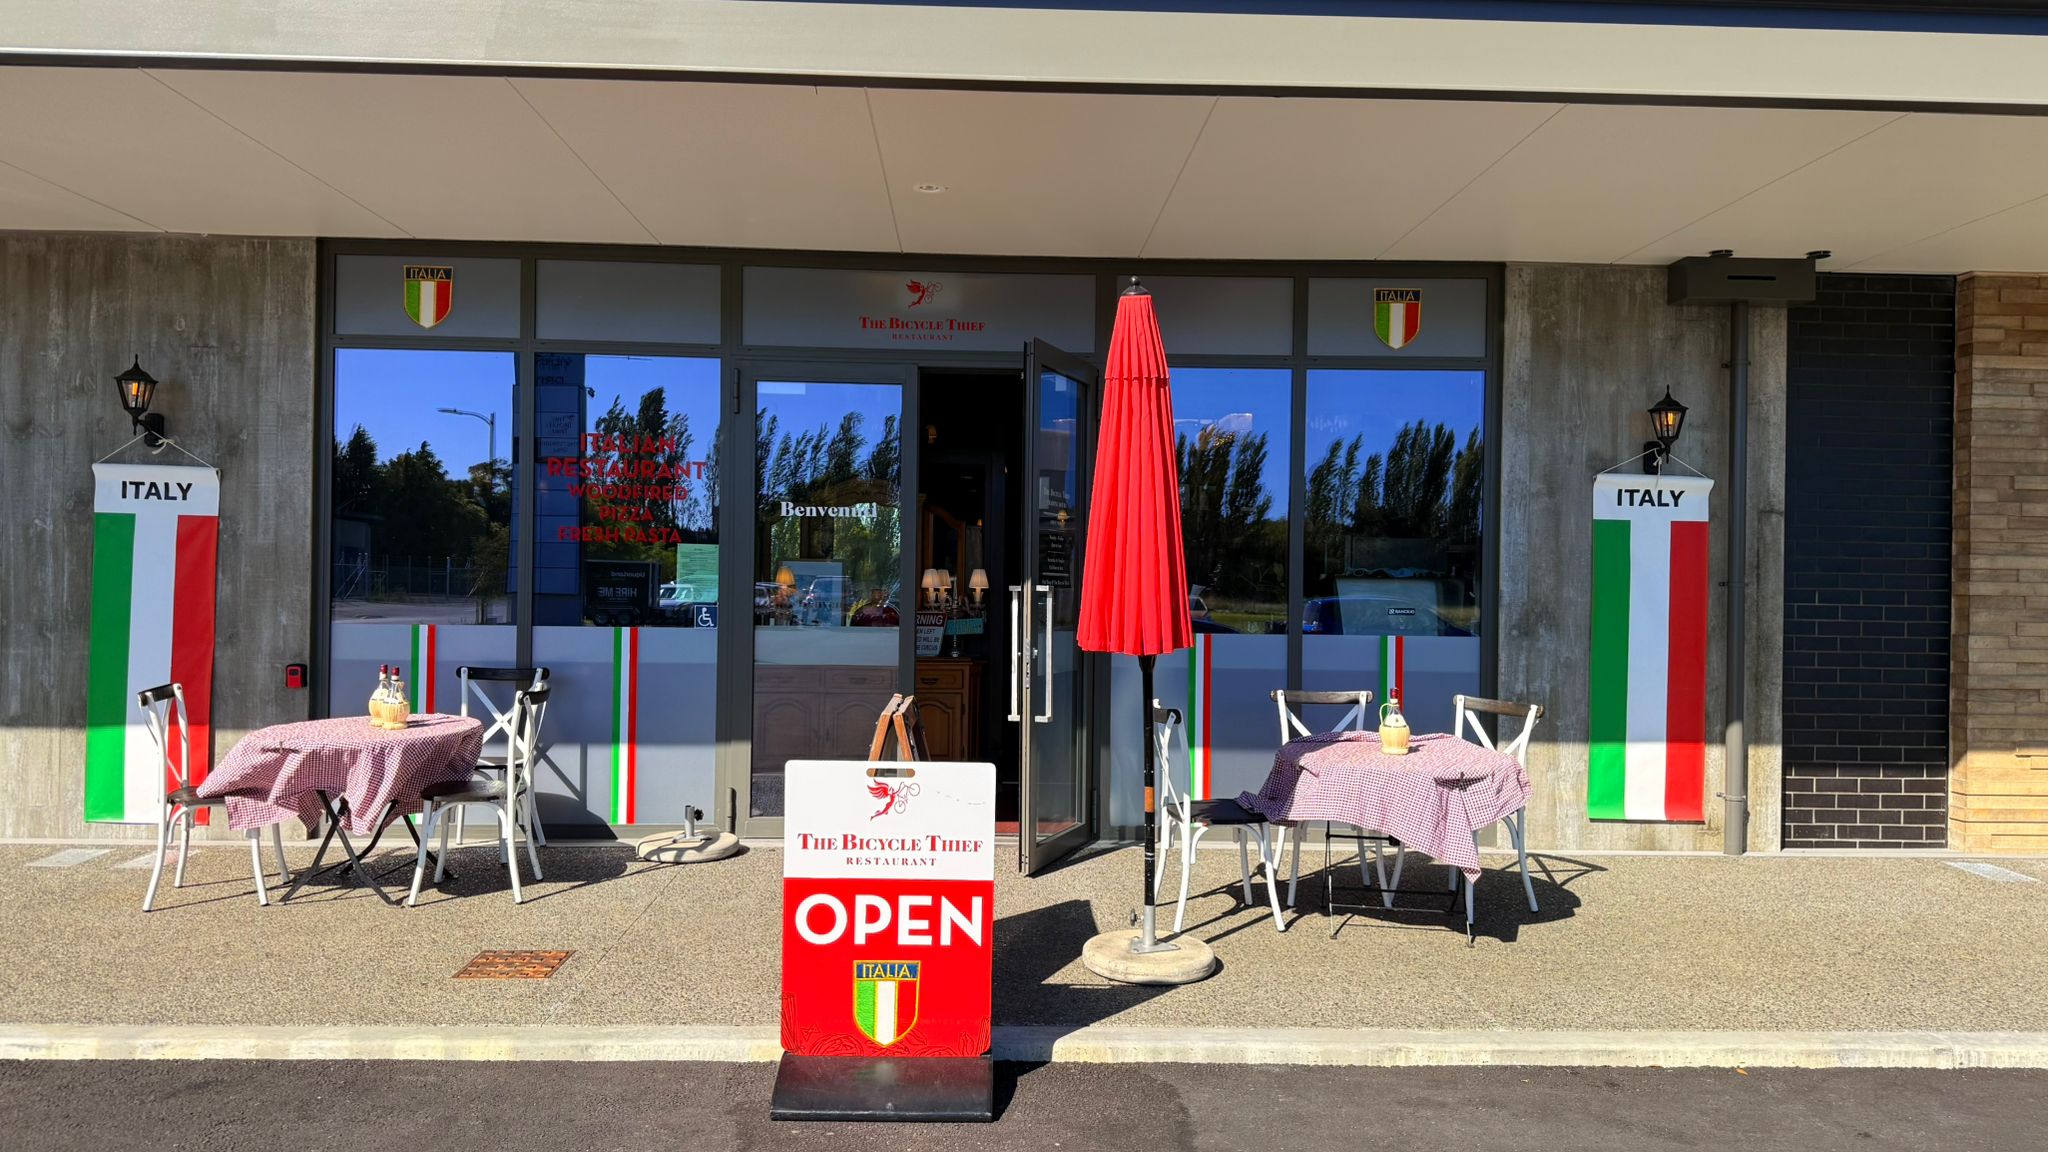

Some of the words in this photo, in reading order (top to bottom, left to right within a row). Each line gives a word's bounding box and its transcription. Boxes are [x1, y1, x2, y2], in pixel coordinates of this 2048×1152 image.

[410, 268, 446, 280] ITALIA
[1380, 290, 1415, 302] ITALIA
[859, 316, 887, 329] THE
[889, 317, 944, 331] BICYCLE
[946, 318, 986, 332] THIEF
[891, 333, 954, 341] RESTAURANT
[580, 432, 676, 454] ITALIAN
[547, 457, 707, 481] RESTAURANT
[121, 480, 193, 501] ITALY
[567, 483, 688, 501] WOODFIRED
[1617, 488, 1685, 507] ITALY
[599, 505, 655, 522] PIZZA
[779, 501, 878, 518] Benvenuti
[557, 527, 620, 543] FRESH
[624, 527, 683, 544] PASTA
[797, 833, 838, 850] THE
[842, 834, 922, 851] BICYCLE
[925, 835, 984, 853] THIEF
[846, 857, 938, 867] RESTAURANT
[795, 893, 983, 947] OPEN
[862, 963, 911, 979] ITALIA
